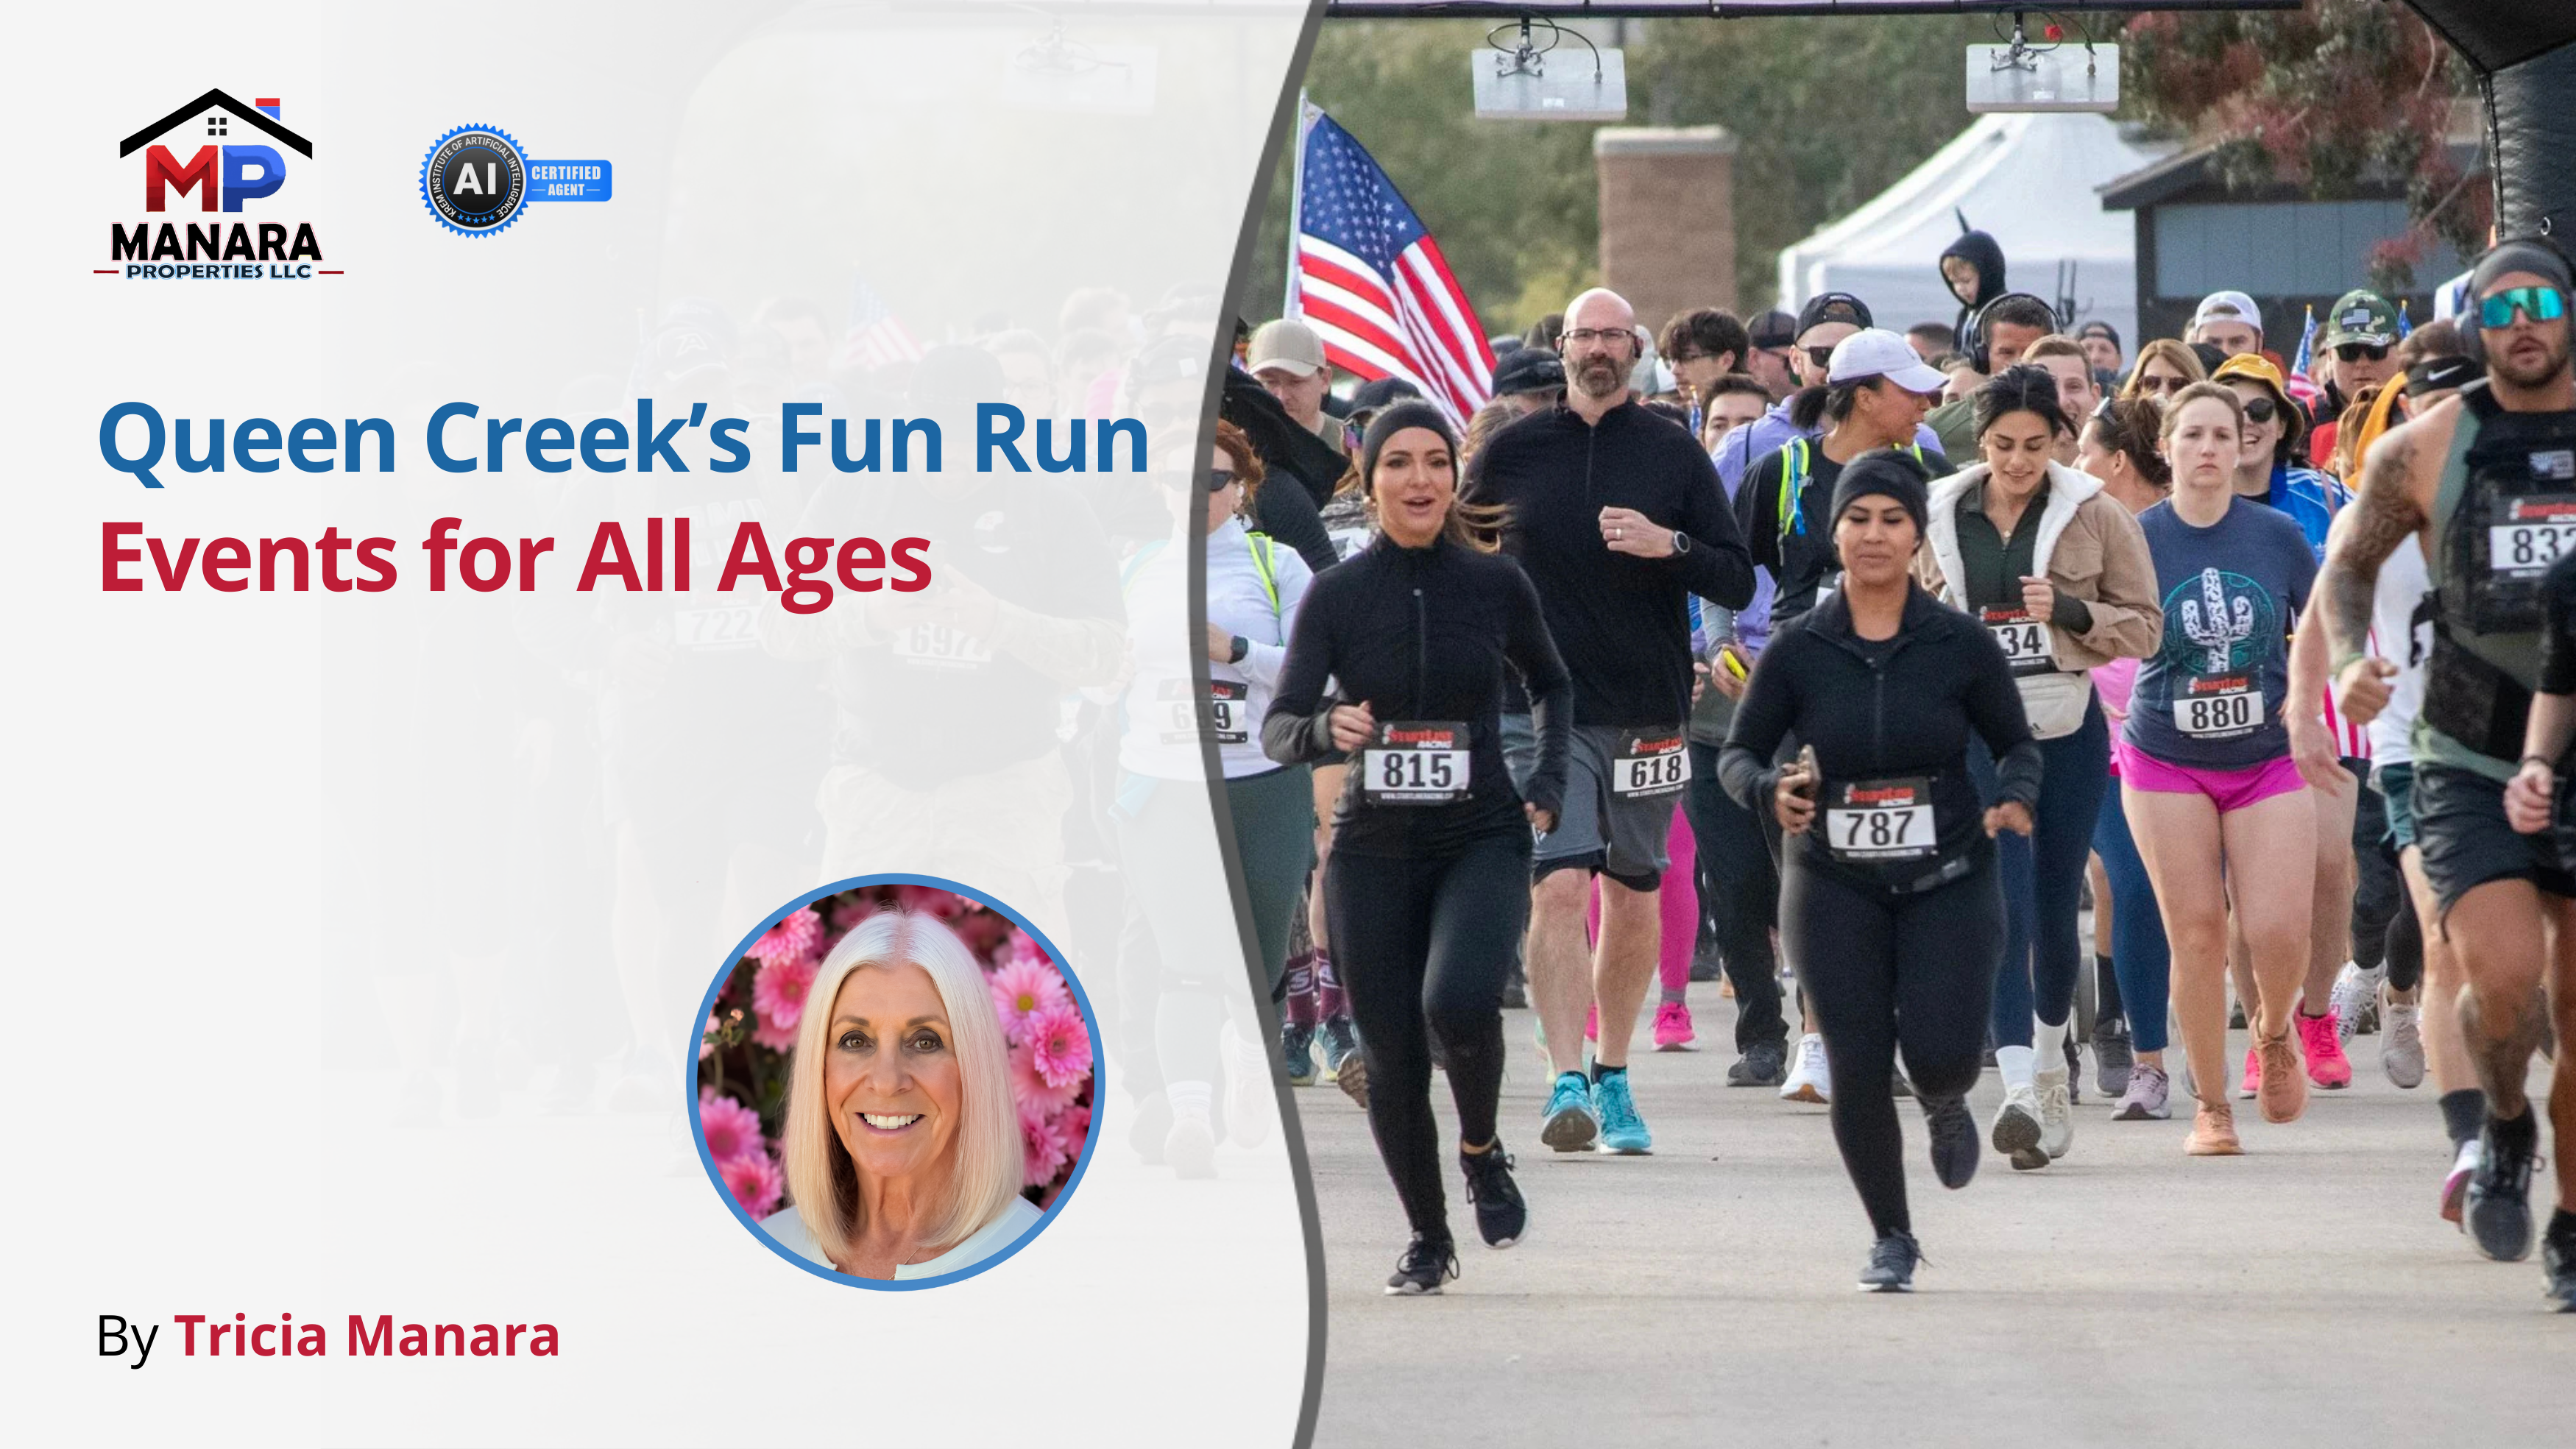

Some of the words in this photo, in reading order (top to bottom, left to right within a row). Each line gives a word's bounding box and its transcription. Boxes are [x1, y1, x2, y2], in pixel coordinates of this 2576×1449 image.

[691, 609, 754, 641] 722
[2191, 696, 2248, 729] 880
[1384, 753, 1453, 787] 815
[1631, 755, 1681, 787] 618
[1846, 810, 1914, 846] 787
